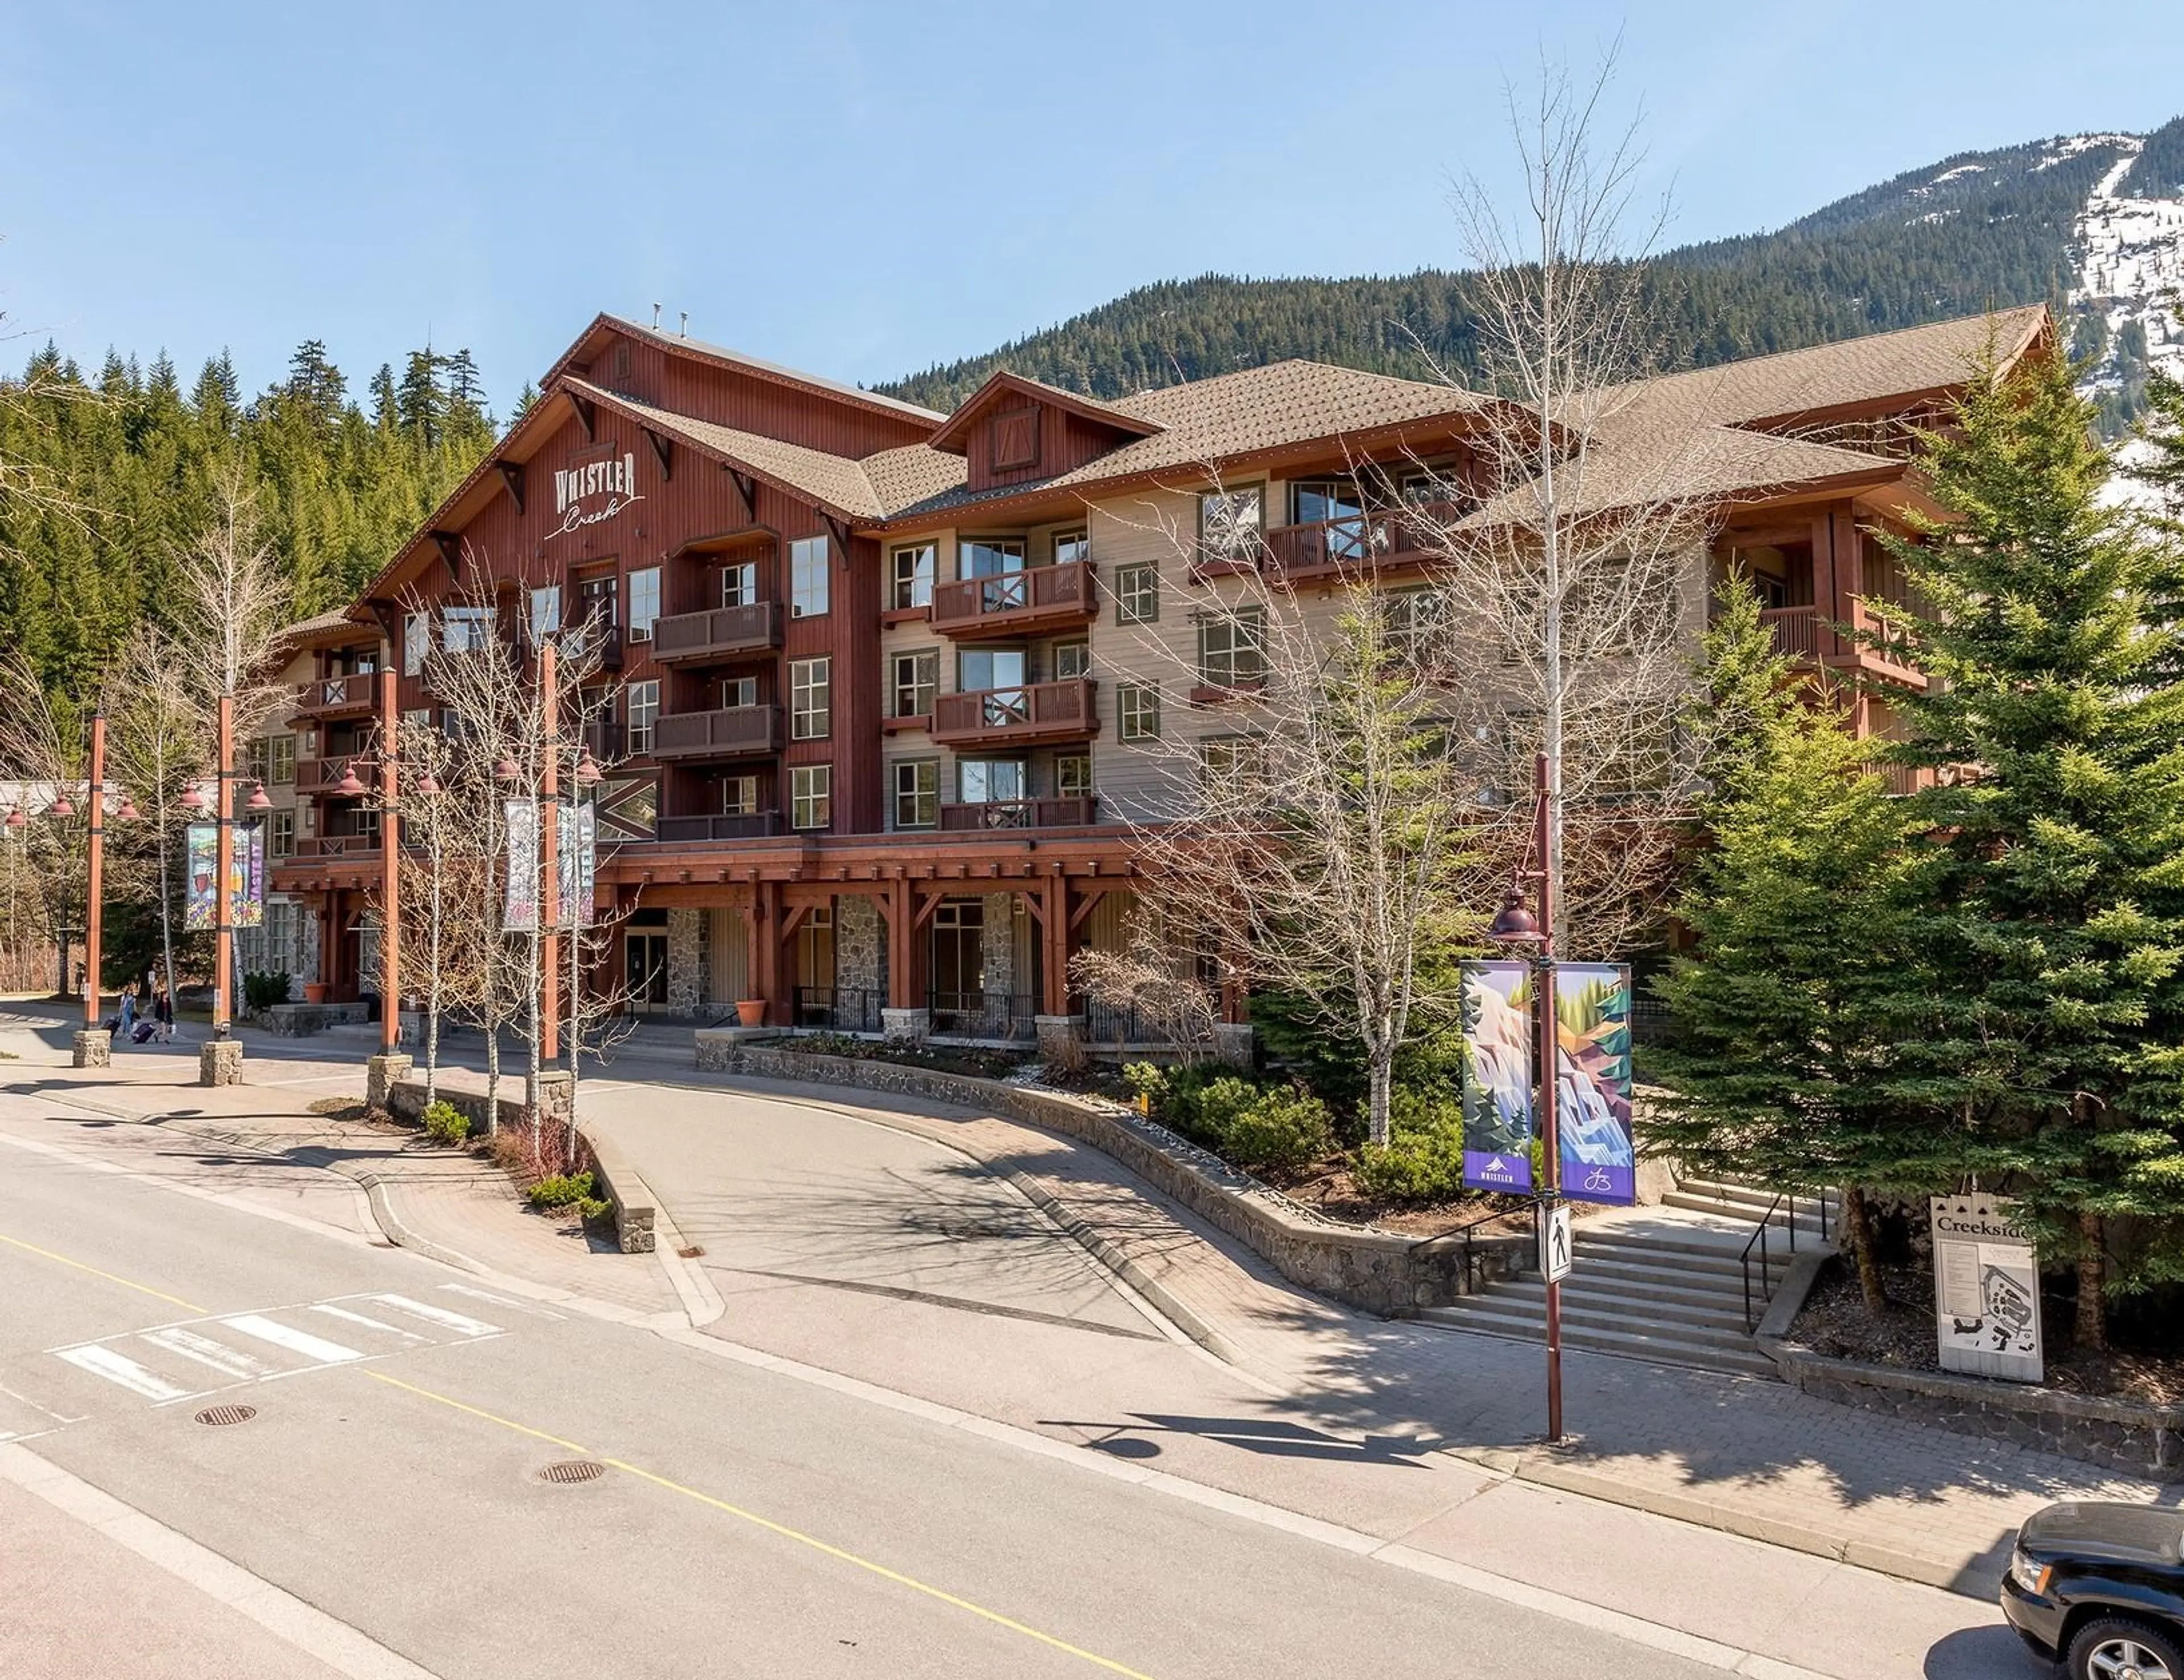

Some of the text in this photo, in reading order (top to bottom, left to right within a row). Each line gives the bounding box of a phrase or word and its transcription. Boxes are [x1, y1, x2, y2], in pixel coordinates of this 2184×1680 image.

[555, 453, 634, 514] WHISTLER
[544, 495, 646, 539] Creek
[250, 843, 262, 901] TASTE IT
[1480, 1172, 1513, 1182] WHISTLER
